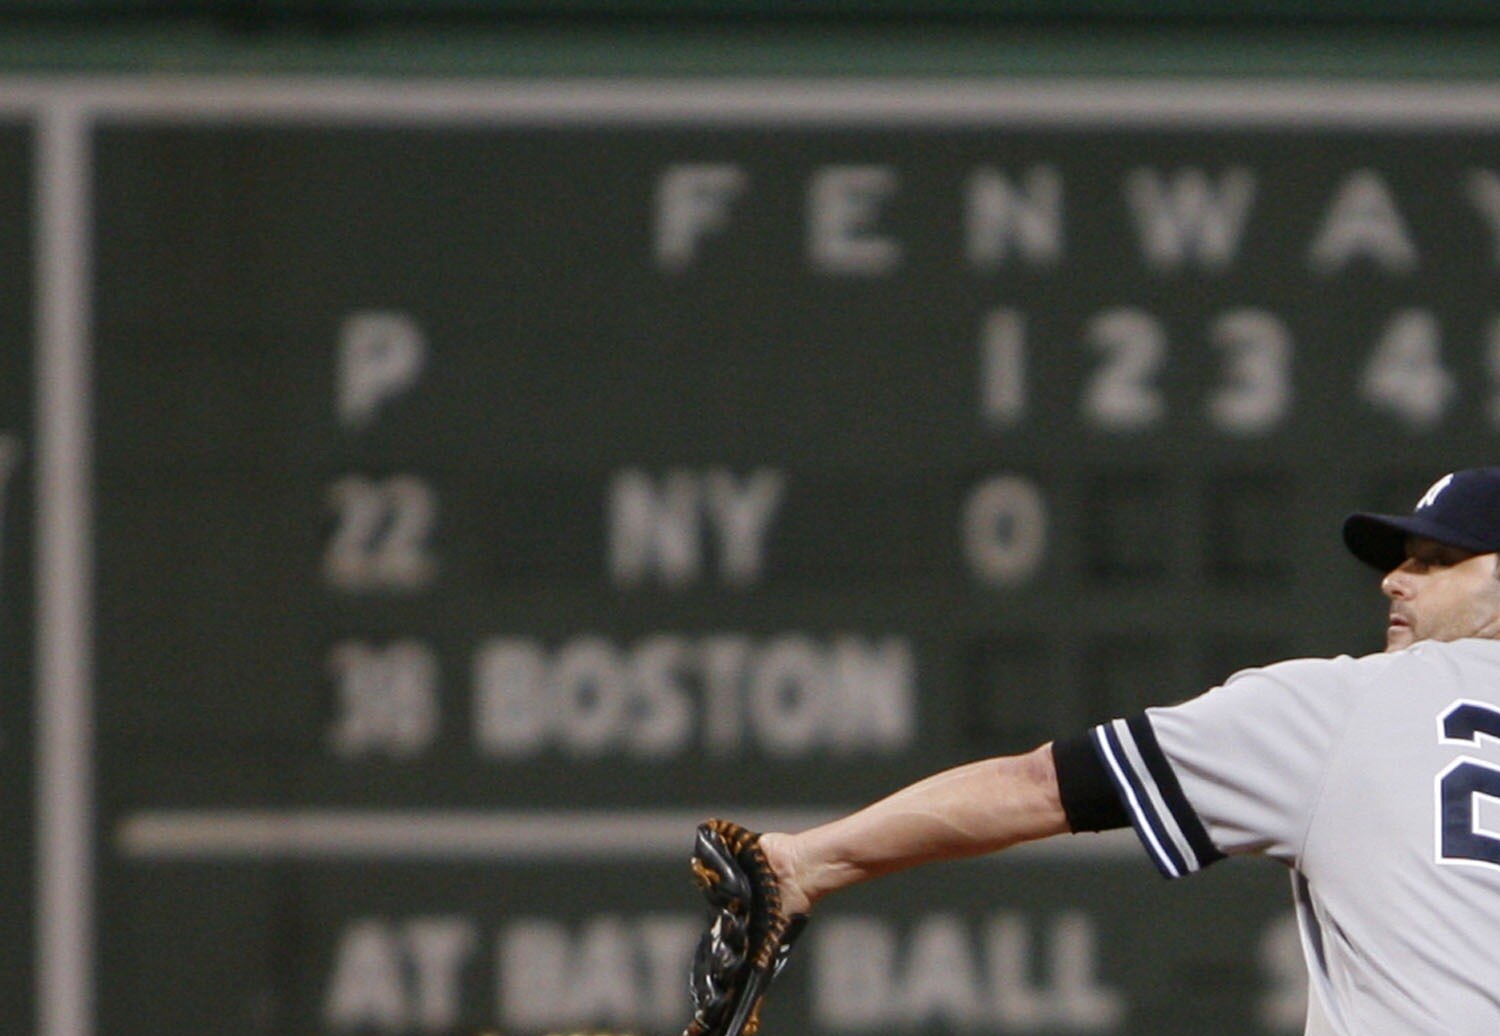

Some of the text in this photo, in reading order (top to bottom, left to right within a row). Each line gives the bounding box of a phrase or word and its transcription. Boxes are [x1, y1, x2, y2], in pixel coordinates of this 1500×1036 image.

[336, 310, 425, 423] P
[1082, 308, 1167, 430] 2
[1208, 308, 1293, 434] 3
[1361, 309, 1456, 427] 4
[327, 476, 436, 588] 22
[609, 468, 783, 586] NY
[963, 475, 1048, 586] 0
[474, 634, 915, 757] BOSTON
[325, 913, 702, 1032] AT BAT
[812, 912, 1122, 1034] BALL
